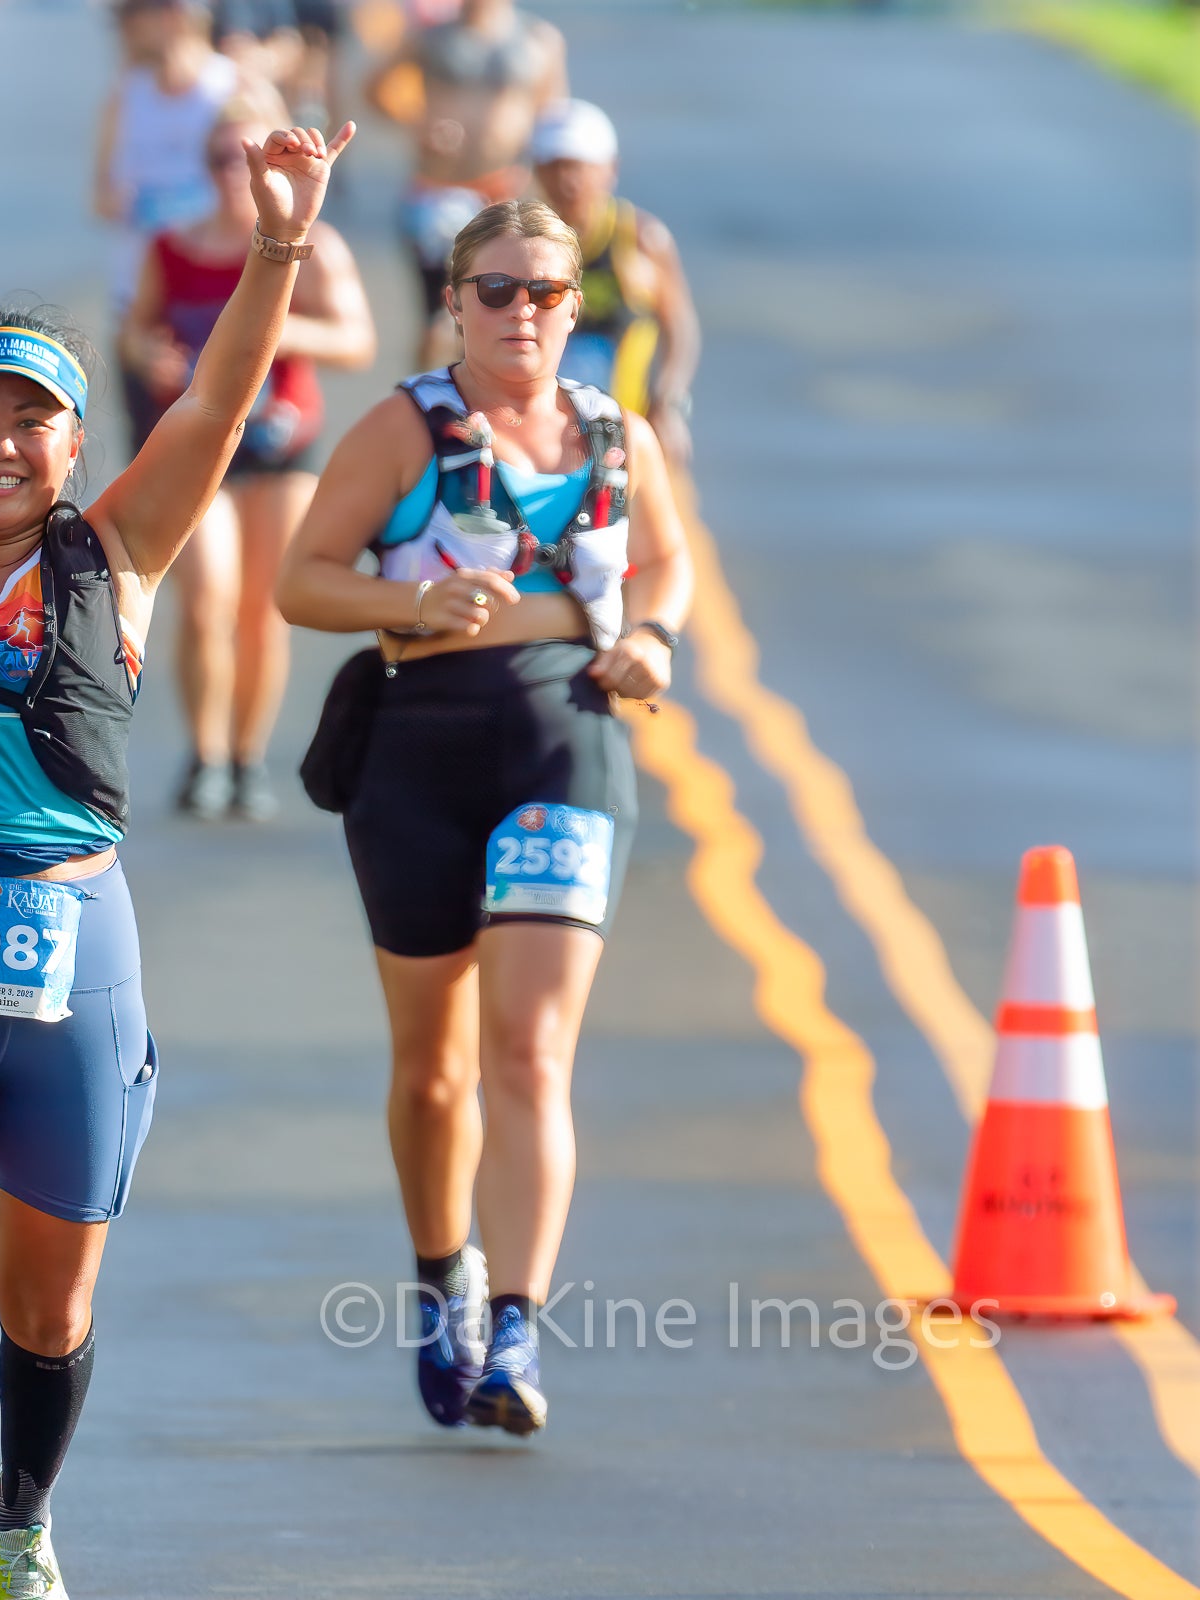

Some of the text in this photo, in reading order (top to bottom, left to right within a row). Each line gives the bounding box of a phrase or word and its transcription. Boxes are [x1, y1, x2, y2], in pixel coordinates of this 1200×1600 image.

[0, 348, 6, 356] &
[7, 987, 16, 998] 3,
[16, 988, 35, 999] 2023
